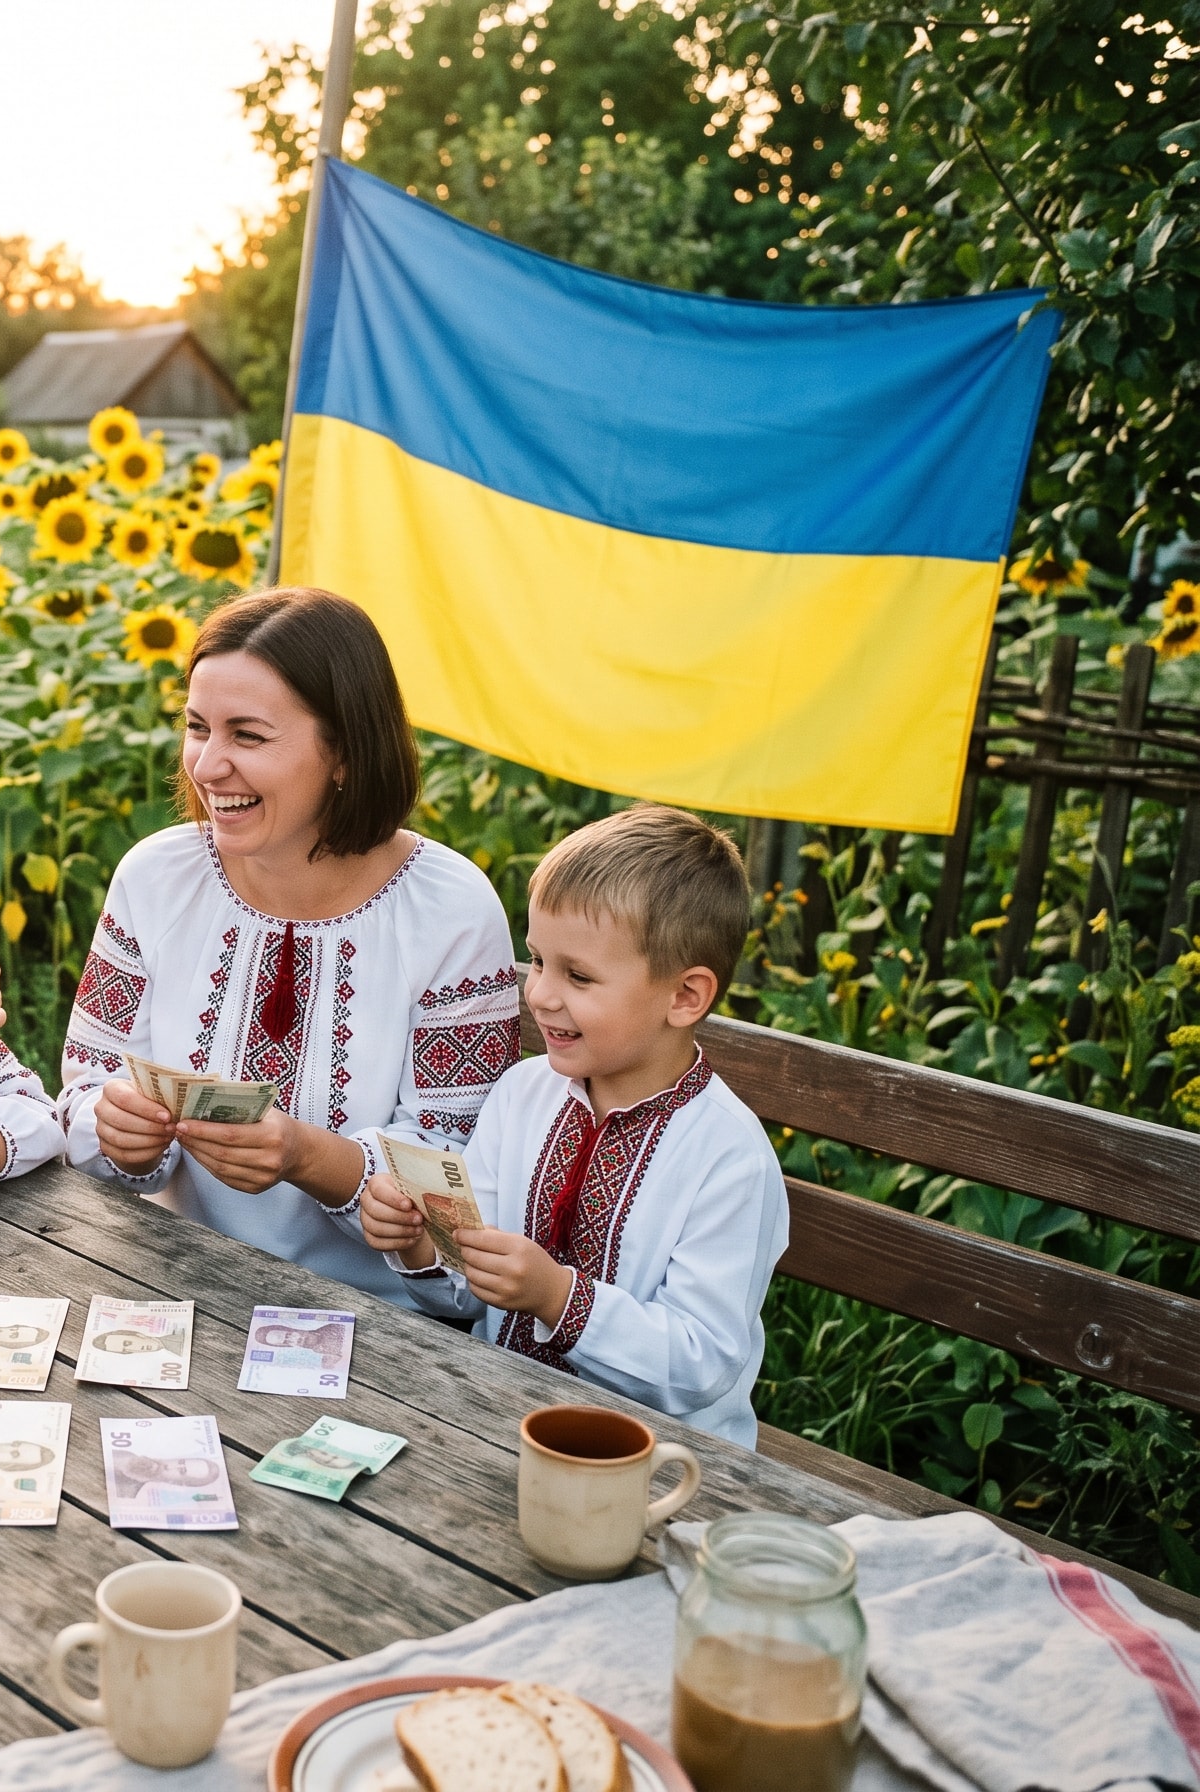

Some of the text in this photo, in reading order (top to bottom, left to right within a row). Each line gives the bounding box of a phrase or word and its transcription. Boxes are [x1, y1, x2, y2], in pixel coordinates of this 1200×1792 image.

[441, 1160, 465, 1189] 100
[319, 1373, 339, 1387] 50
[110, 1431, 132, 1448] 50
